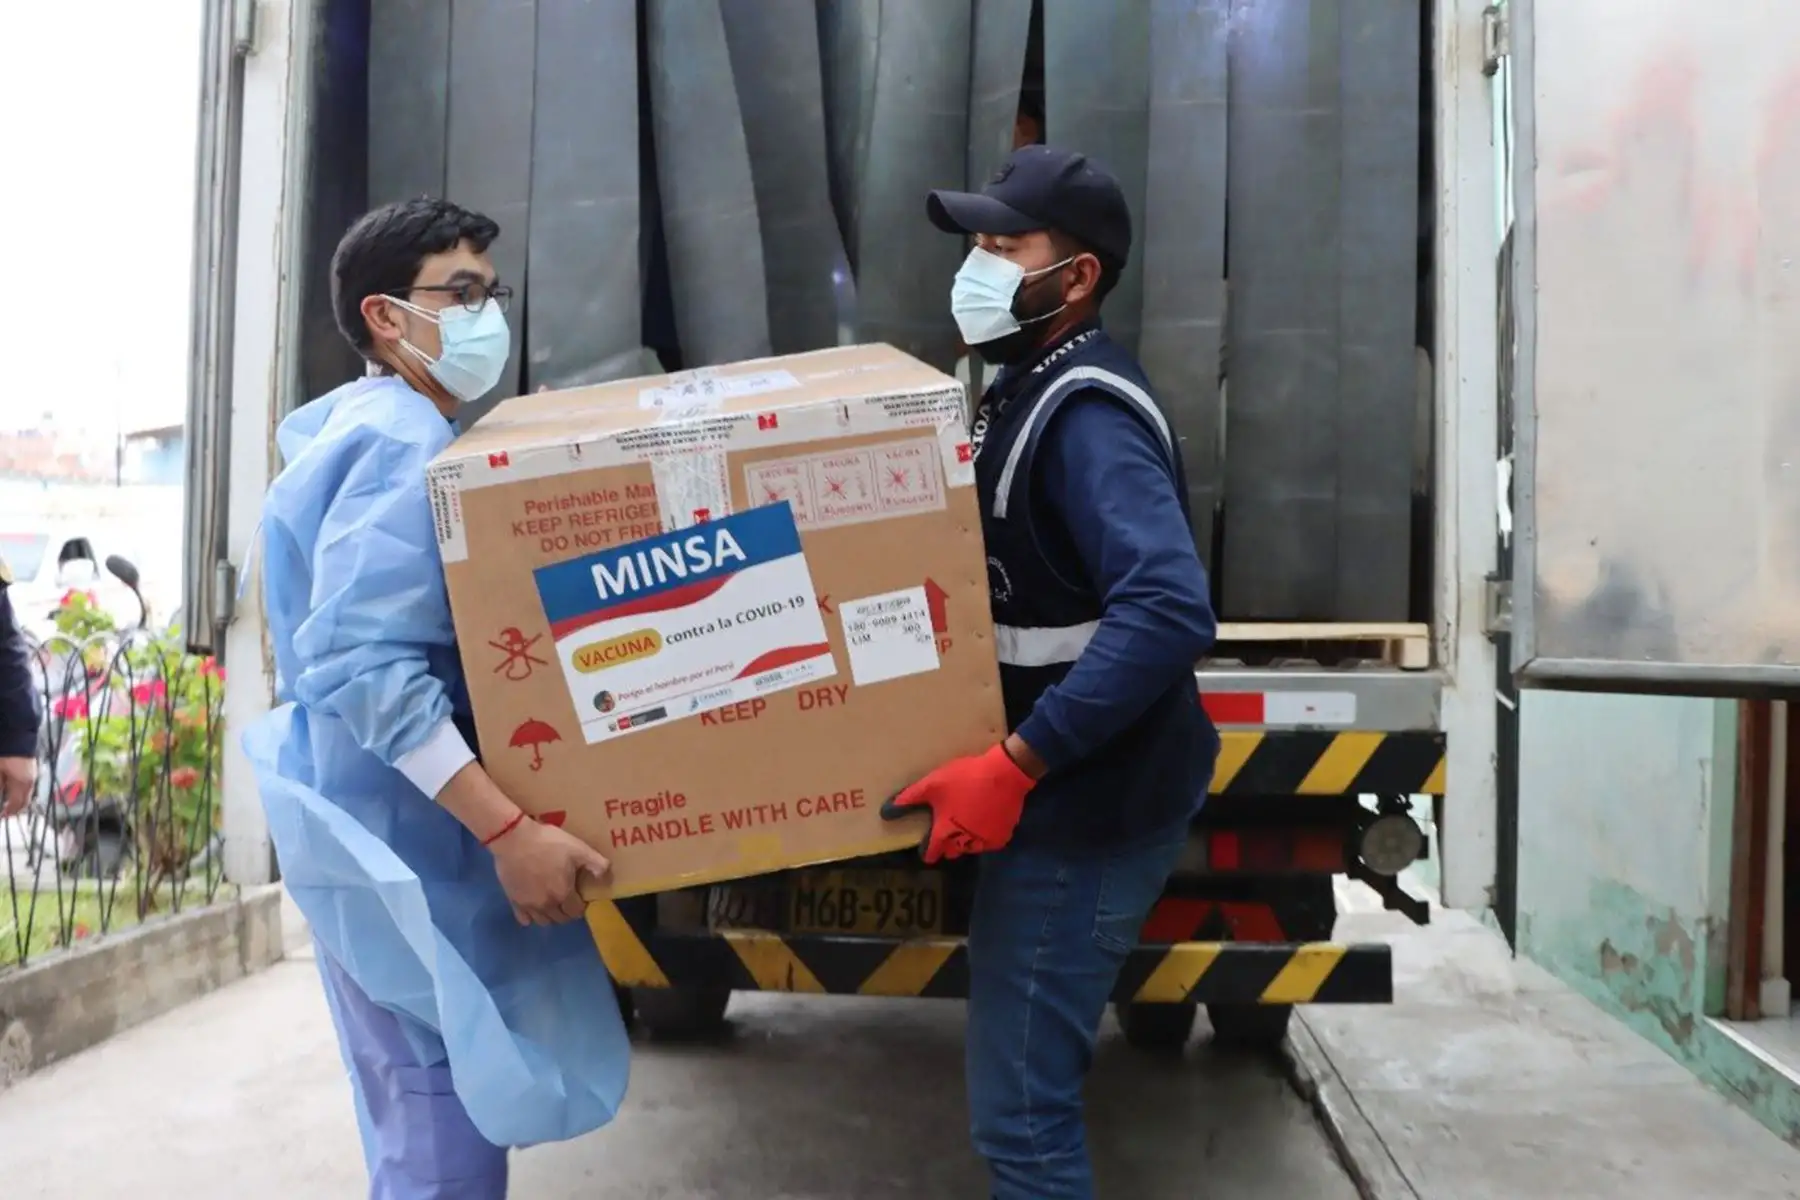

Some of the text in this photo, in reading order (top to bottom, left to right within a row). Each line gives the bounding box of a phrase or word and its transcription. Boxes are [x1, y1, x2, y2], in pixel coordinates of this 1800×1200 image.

[525, 490, 618, 515] Perishable
[512, 516, 562, 537] KEEP
[541, 536, 569, 553] DO
[575, 528, 614, 548] NOT
[591, 528, 747, 600] MINSA
[579, 636, 656, 668] VACUNA
[665, 623, 716, 645] contra
[719, 617, 732, 630] la
[736, 596, 805, 624] COVID-19
[701, 698, 767, 727] KEEP
[798, 684, 848, 712] DRY
[604, 789, 687, 819] Fragile
[610, 788, 866, 850] HANDLE WITH CARE
[794, 887, 938, 930] M6B-930
